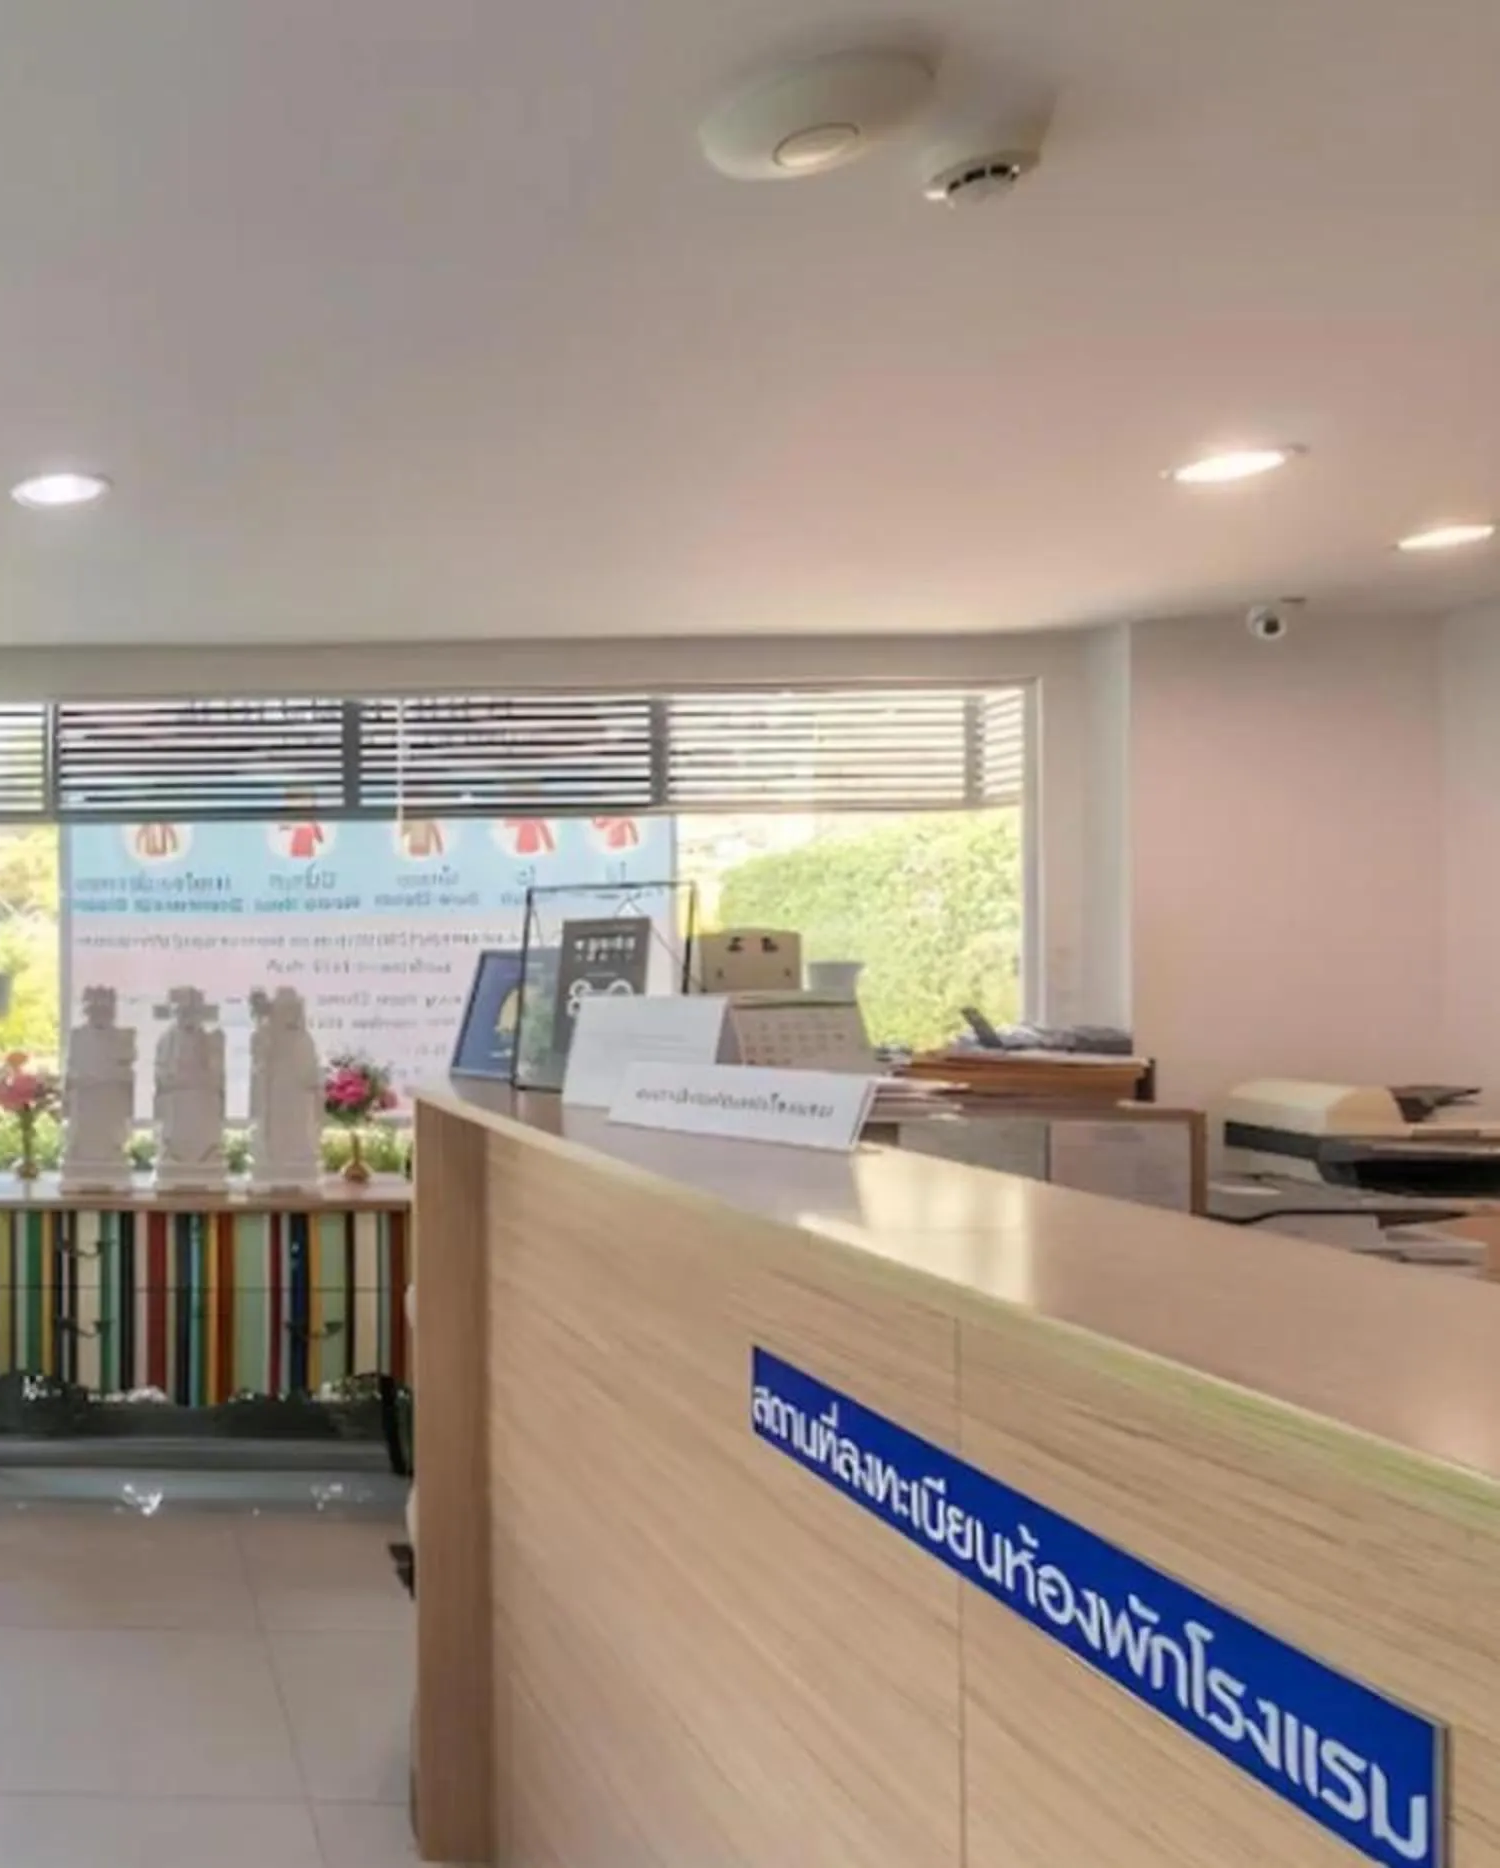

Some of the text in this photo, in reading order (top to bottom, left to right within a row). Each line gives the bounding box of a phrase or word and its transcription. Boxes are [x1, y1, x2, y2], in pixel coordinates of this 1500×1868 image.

[753, 1385, 1428, 1861] สถานที่ลงทะเบียนห้องพักโรงแรม
